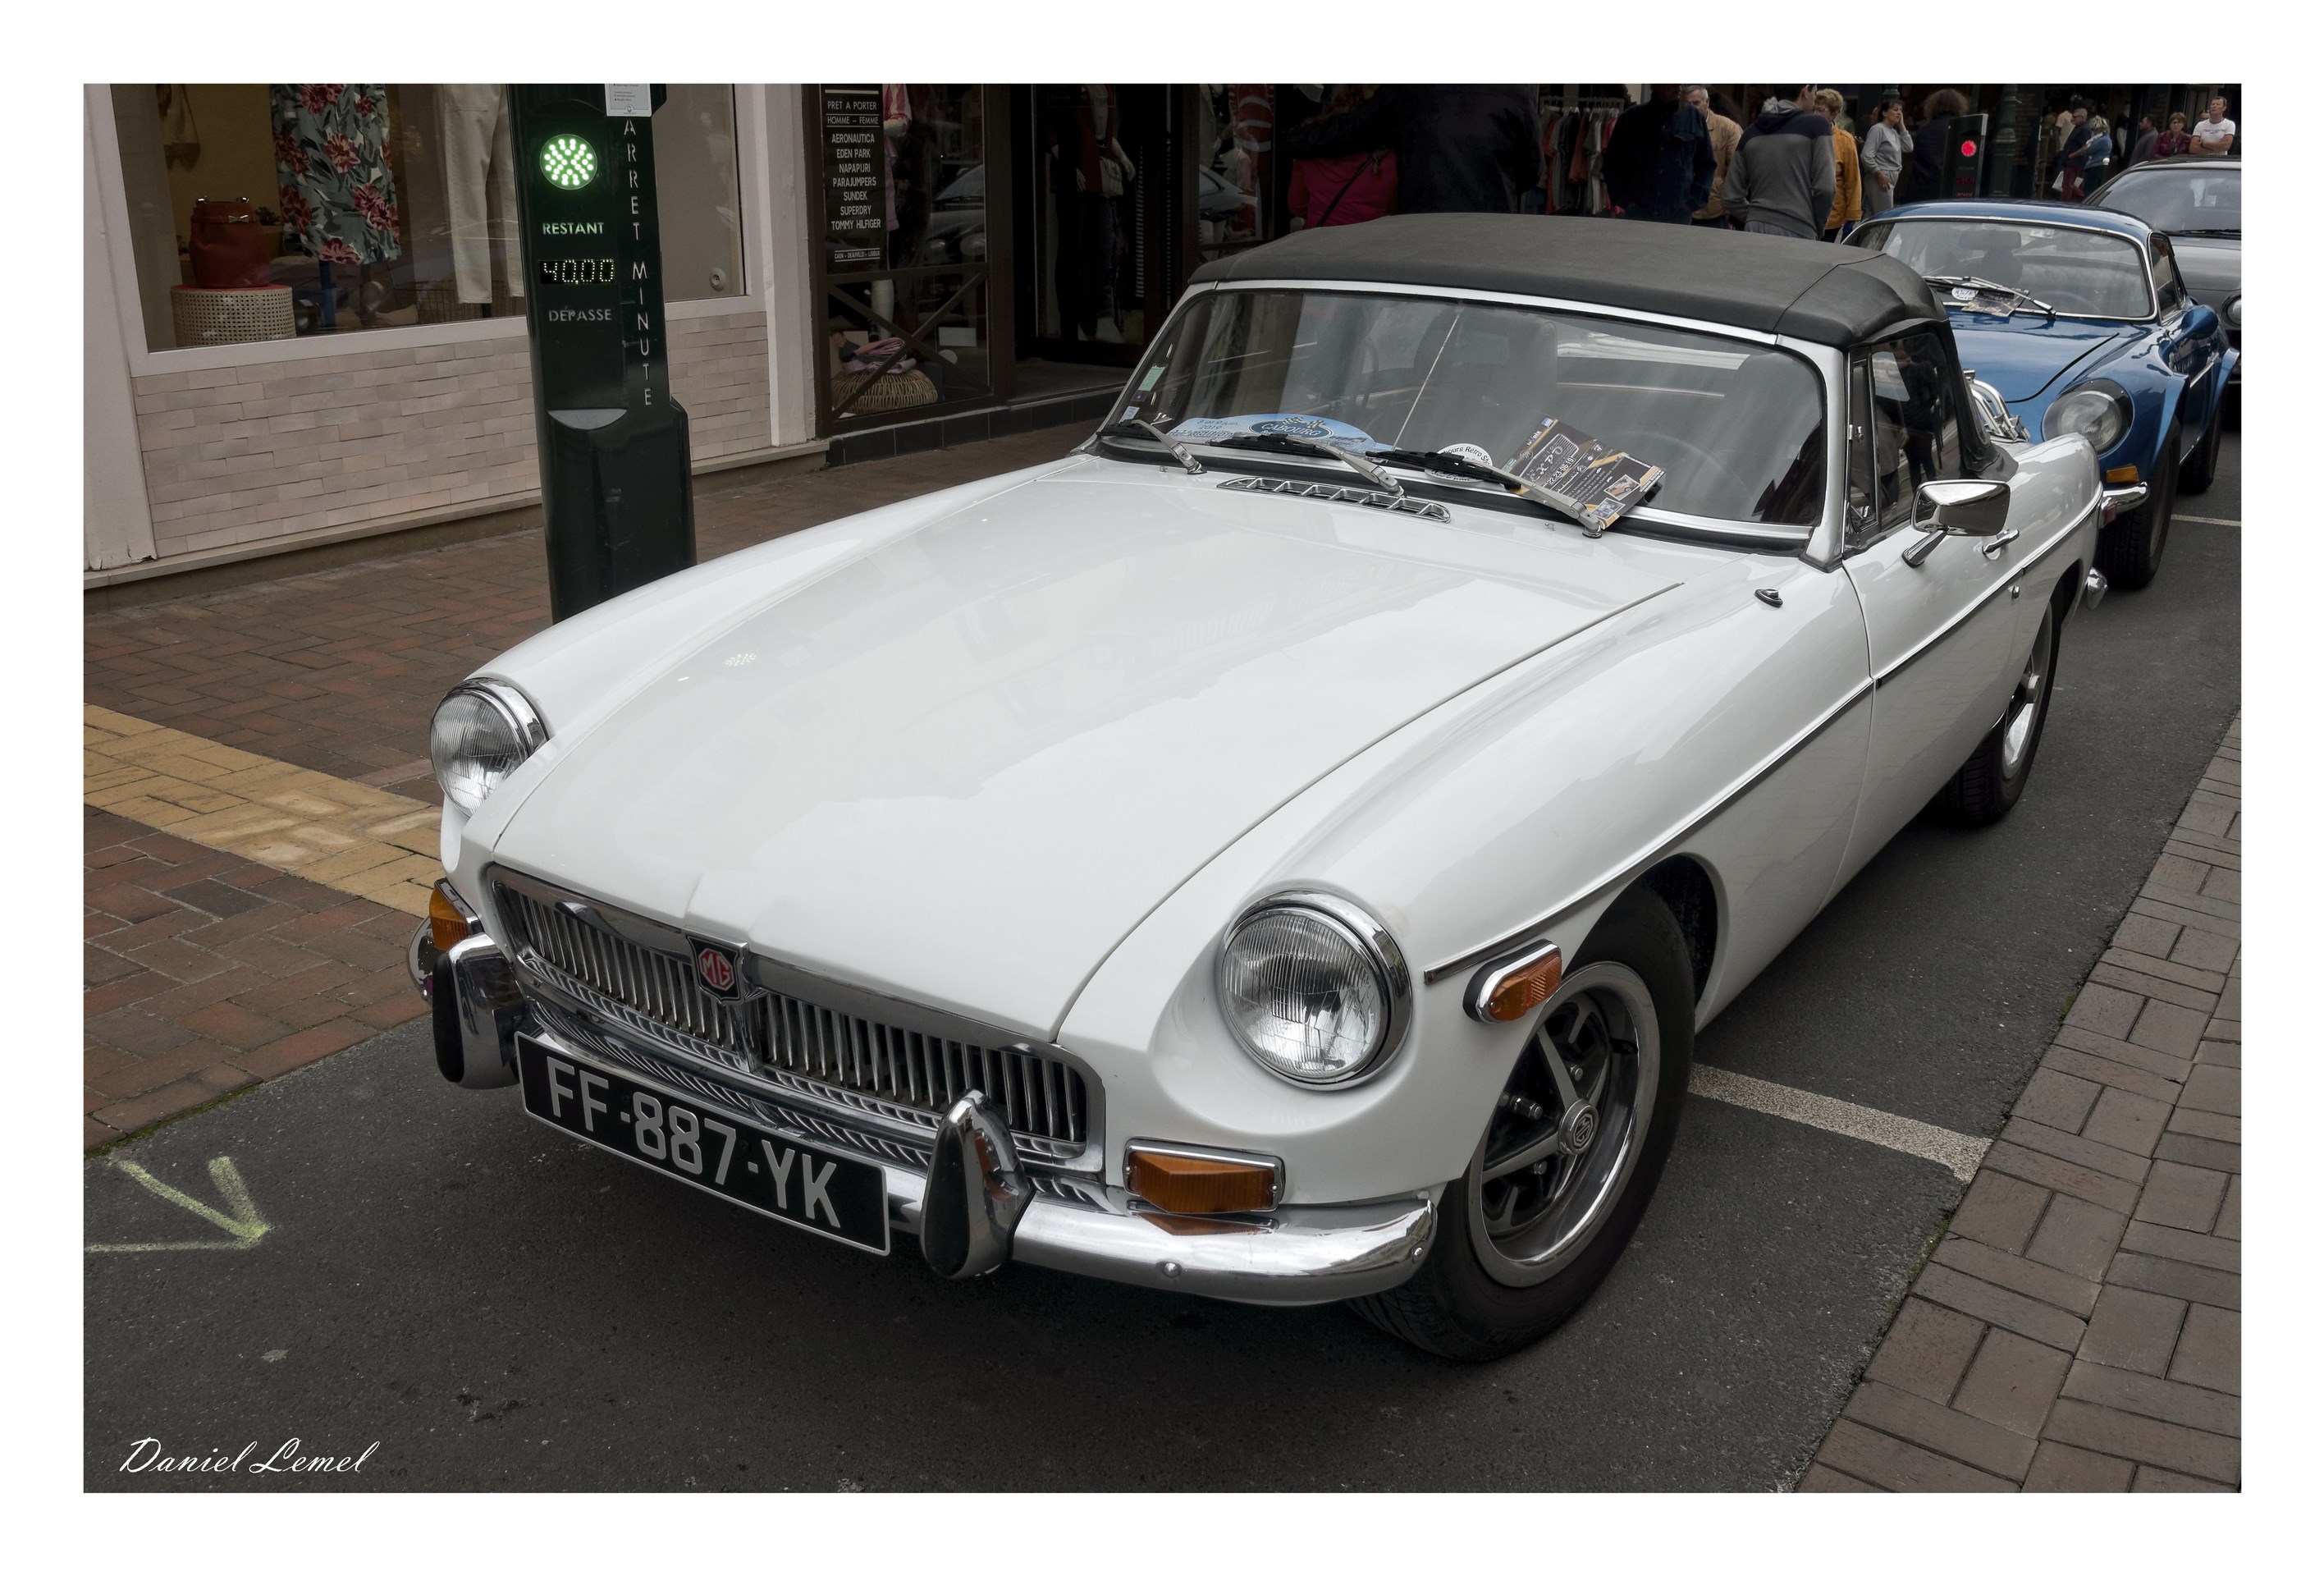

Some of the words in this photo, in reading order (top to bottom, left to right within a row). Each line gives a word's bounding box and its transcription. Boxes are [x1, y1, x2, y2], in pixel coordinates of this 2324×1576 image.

[827, 101, 843, 110] PRET
[845, 102, 851, 110] A
[853, 101, 877, 111] PORTER
[827, 116, 850, 125] HOMME
[859, 116, 879, 125] FEMME
[831, 133, 875, 144] AERONAUTICA
[836, 149, 853, 158] EDEN
[854, 149, 871, 158] PARK
[839, 163, 871, 173] NAPAPIJRI
[833, 176, 876, 187] PARAJUMPERS
[844, 190, 867, 201] SUNDEK
[839, 205, 872, 216] SUPERDRY
[542, 222, 605, 235] RESTANT
[831, 220, 854, 231] TOMMY
[856, 218, 881, 229] HILFIGER
[624, 119, 640, 241] ARRET
[632, 260, 652, 405] MINUTE
[1260, 423, 1322, 436] CABOURG
[700, 953, 733, 985] MG
[1575, 1116, 1591, 1144] MG
[547, 1056, 841, 1228] FF-887-YK
